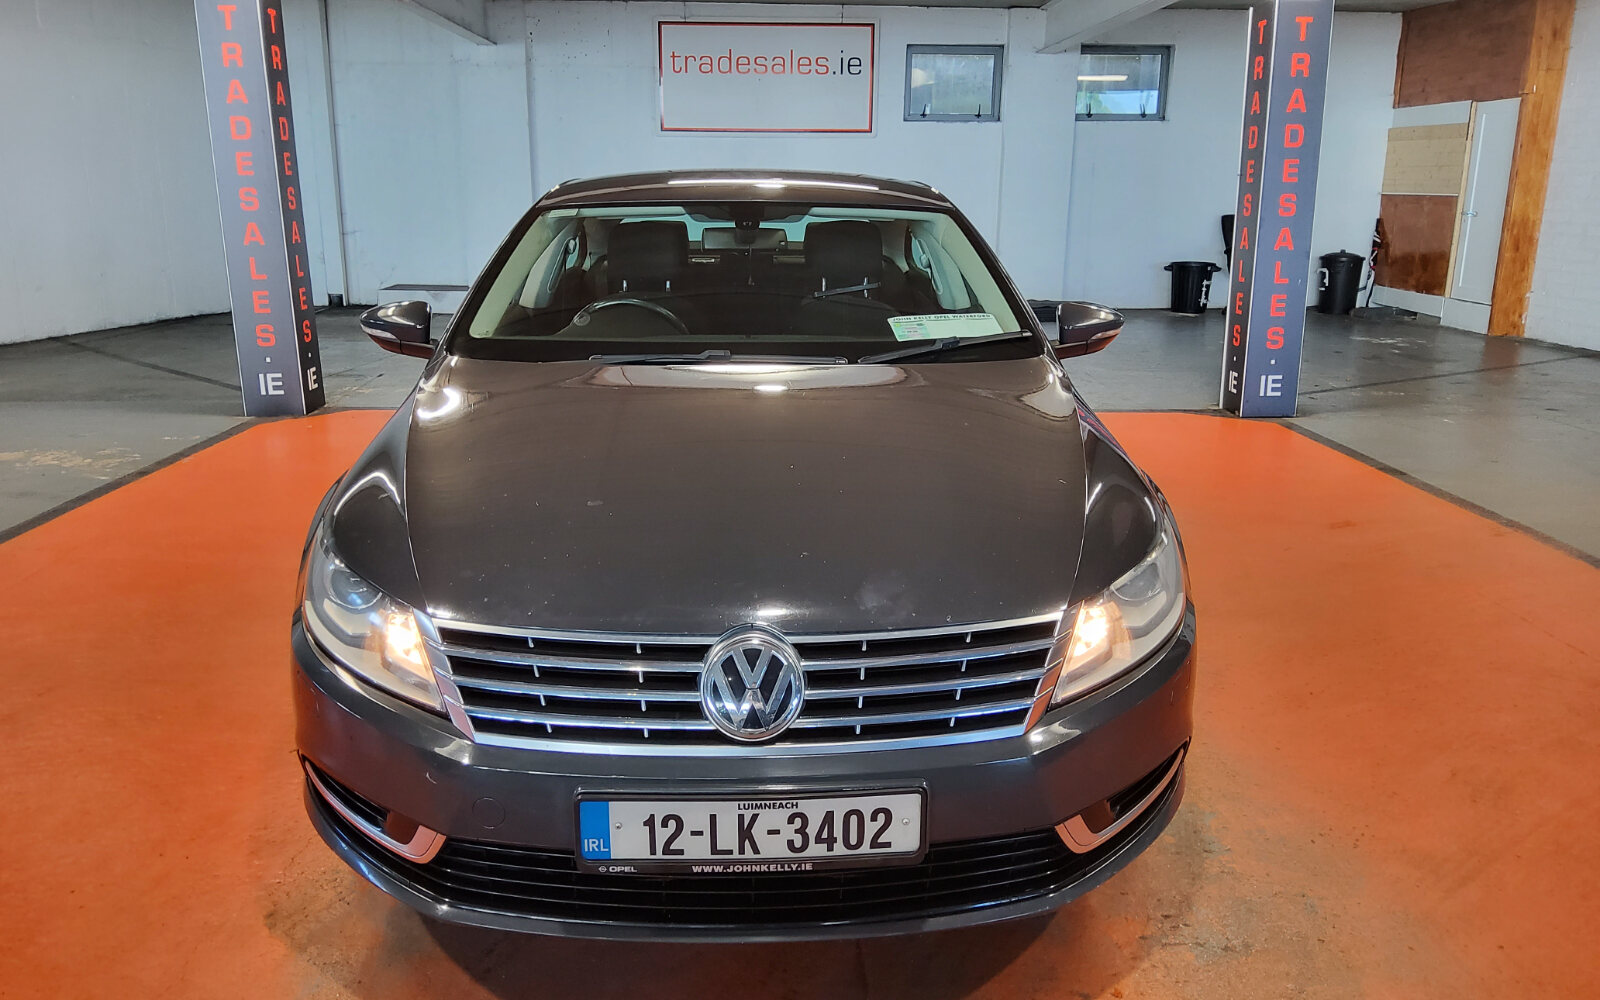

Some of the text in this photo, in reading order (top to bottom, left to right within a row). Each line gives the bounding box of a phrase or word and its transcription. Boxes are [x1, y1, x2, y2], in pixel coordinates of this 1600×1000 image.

[669, 48, 863, 76] tradesales.ie
[737, 801, 799, 811] LUIMNEACH
[642, 807, 893, 857] 12-LK-3402
[584, 838, 609, 852] IRL
[608, 865, 638, 873] OPEL
[691, 862, 813, 873] WWW.JOHNKELLY.IE
